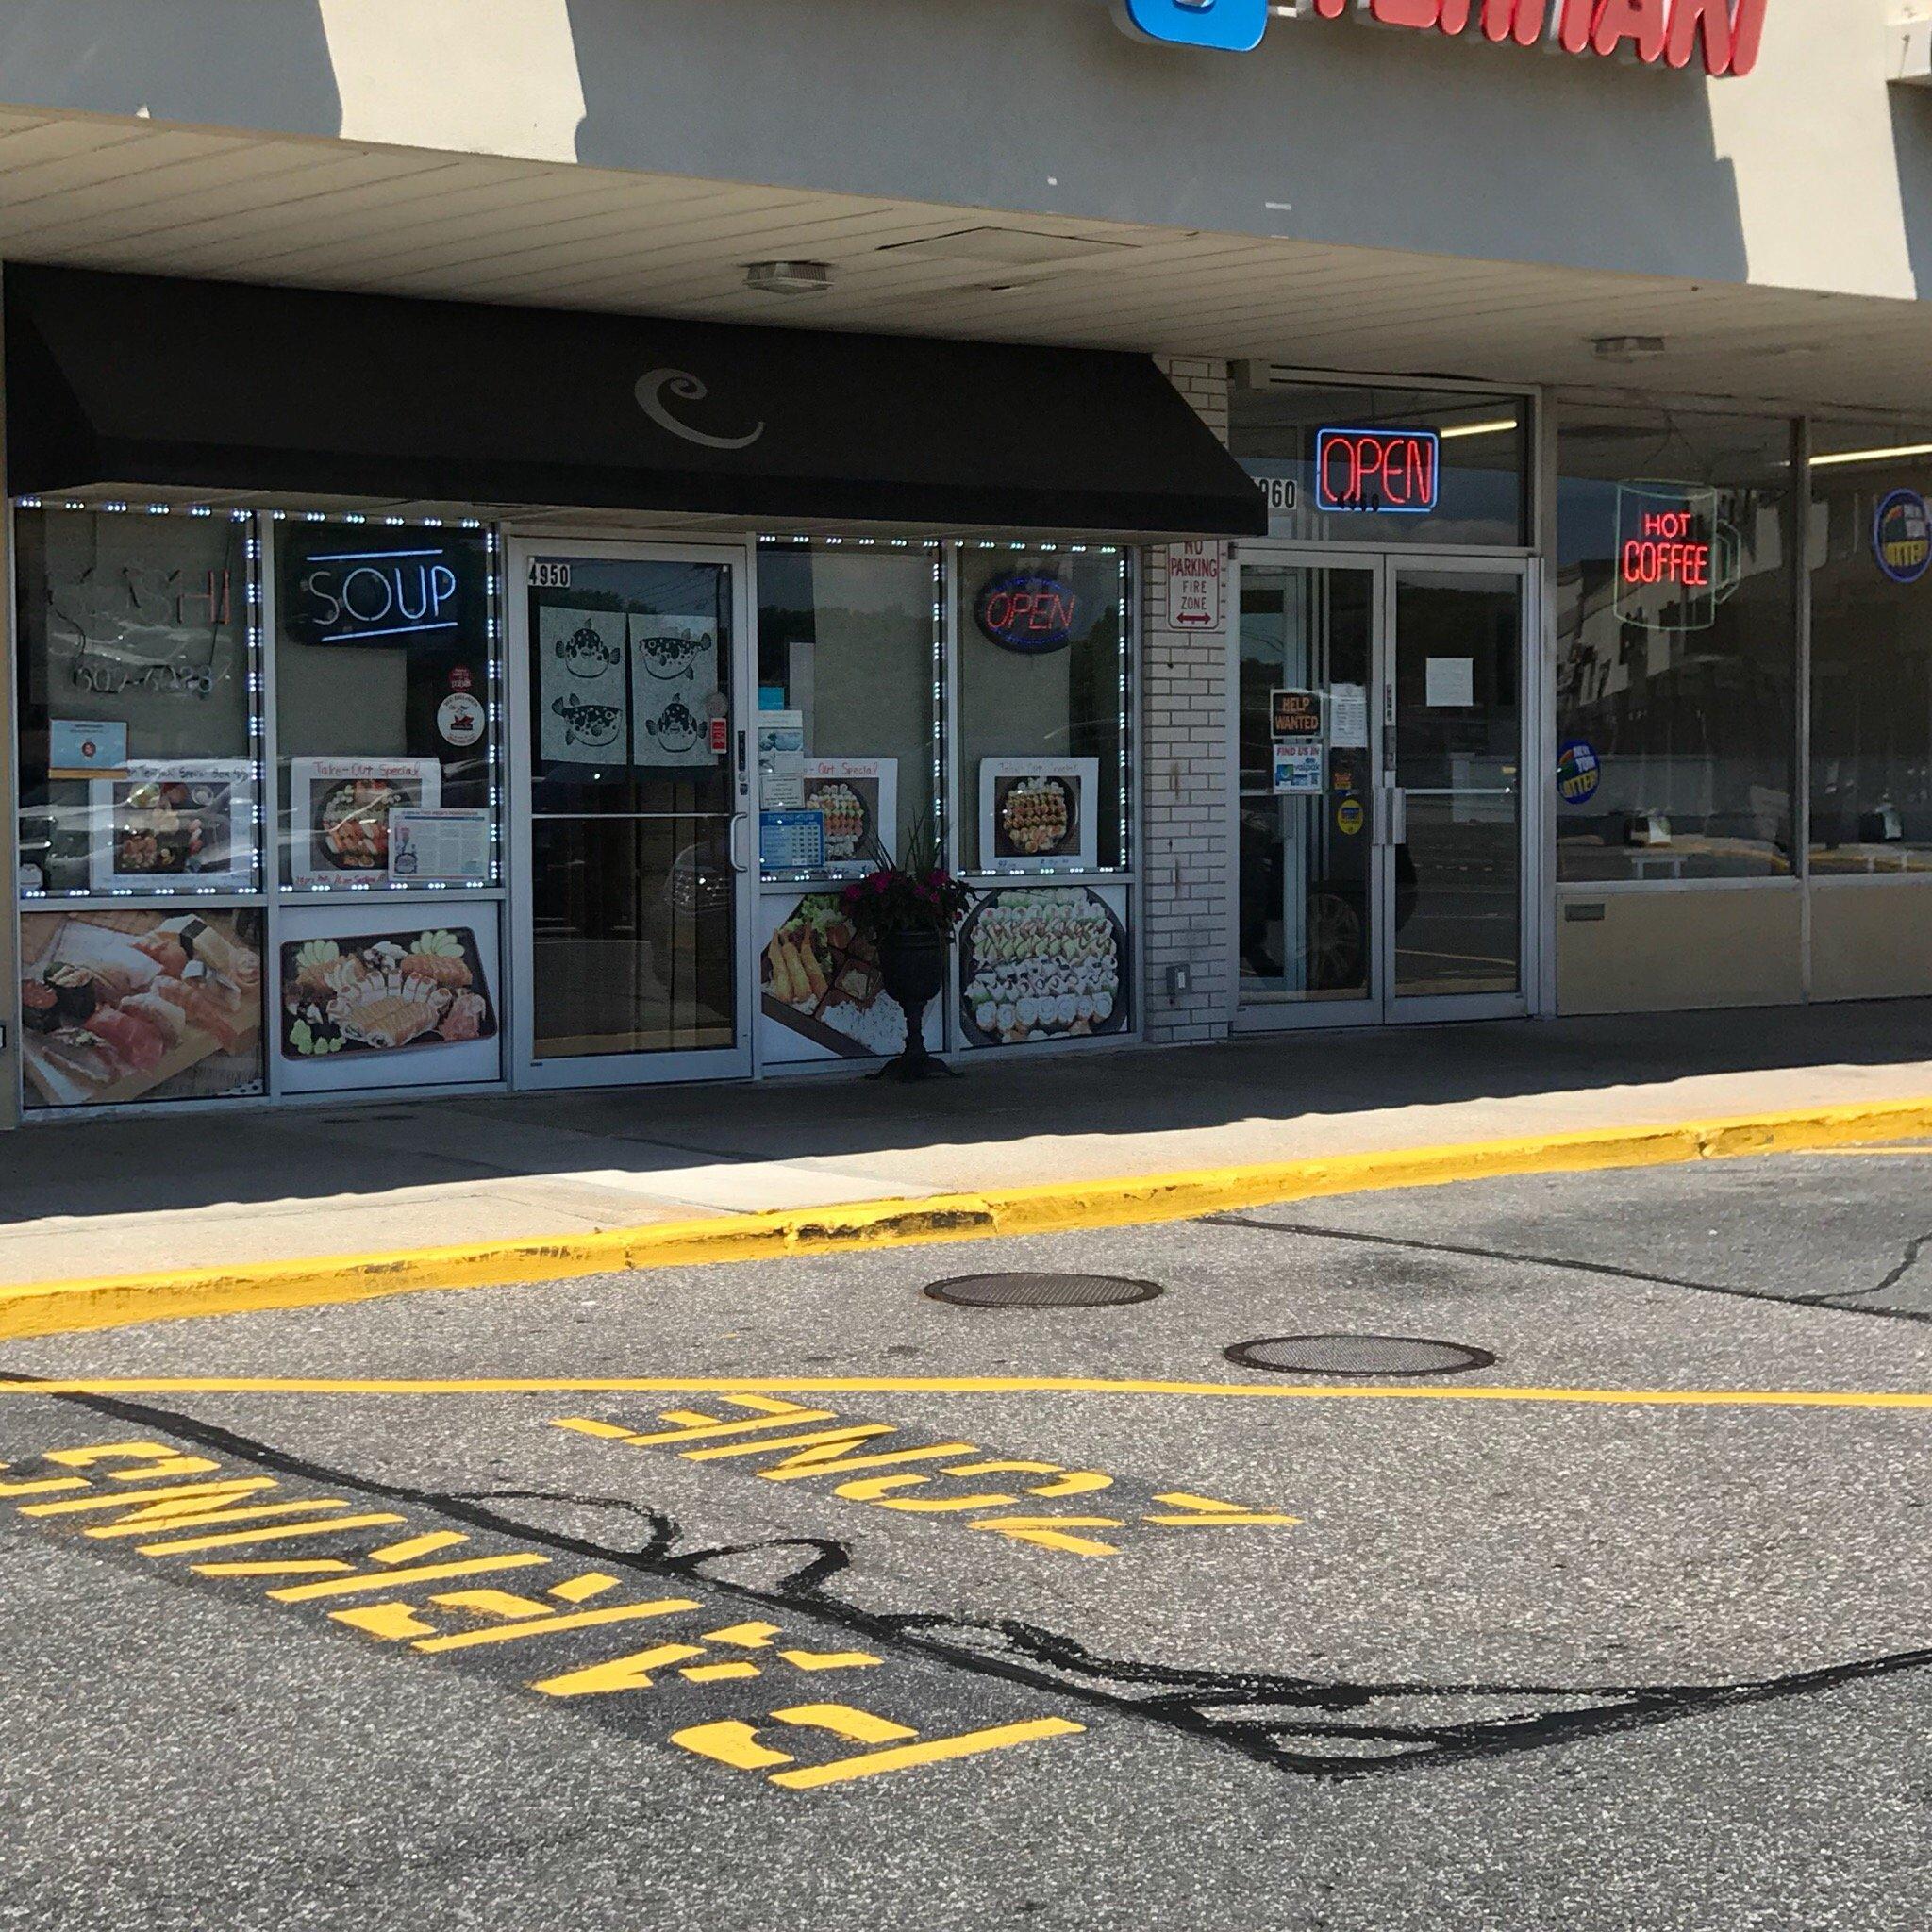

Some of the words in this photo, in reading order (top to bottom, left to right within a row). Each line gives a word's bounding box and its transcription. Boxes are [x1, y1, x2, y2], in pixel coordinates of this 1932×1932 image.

[1323, 437, 1434, 504] OPEN
[1259, 478, 1295, 509] 960
[1644, 512, 1691, 539] HOT
[1171, 558, 1217, 578] PARKING
[1623, 541, 1709, 587] COFFEE
[529, 566, 570, 586] 4950
[308, 565, 458, 626] SOUP
[1182, 580, 1207, 594] FIRE
[985, 591, 1076, 632] OPEN
[1180, 596, 1207, 611] ZONE
[1282, 697, 1310, 711] HELP
[1275, 714, 1319, 730] WANTED
[1276, 747, 1296, 757] FIND
[1298, 747, 1309, 756] US
[313, 761, 372, 776] Take-Out
[378, 760, 420, 779] Special
[841, 761, 877, 775] Special
[550, 1392, 1300, 1557] ZONE
[0, 1441, 1087, 1790] PARKING
